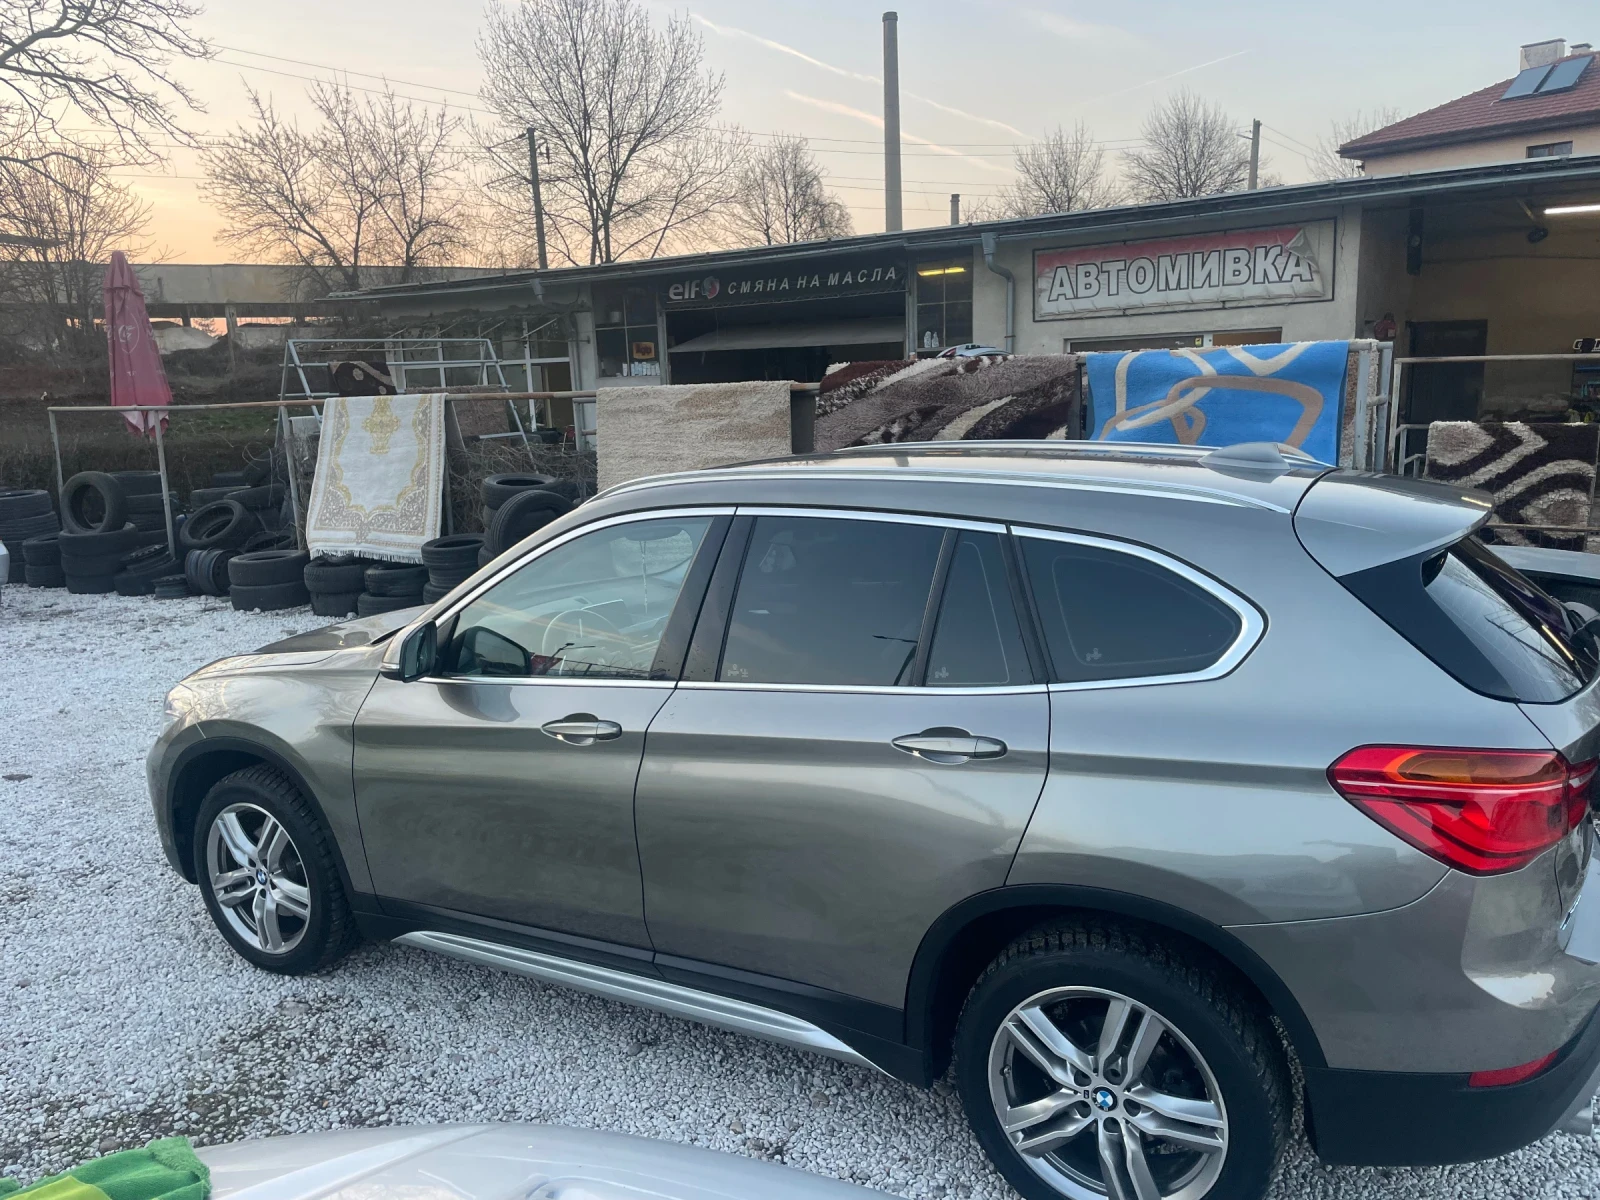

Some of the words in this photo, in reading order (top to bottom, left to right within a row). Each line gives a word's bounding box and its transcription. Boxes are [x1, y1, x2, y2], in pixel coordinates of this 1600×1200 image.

[728, 278, 789, 295] СМЯНА
[797, 274, 820, 289] НА
[828, 267, 896, 286] МАСЛА
[1048, 245, 1314, 302] АВТОМИВКА
[668, 280, 700, 300] elf
